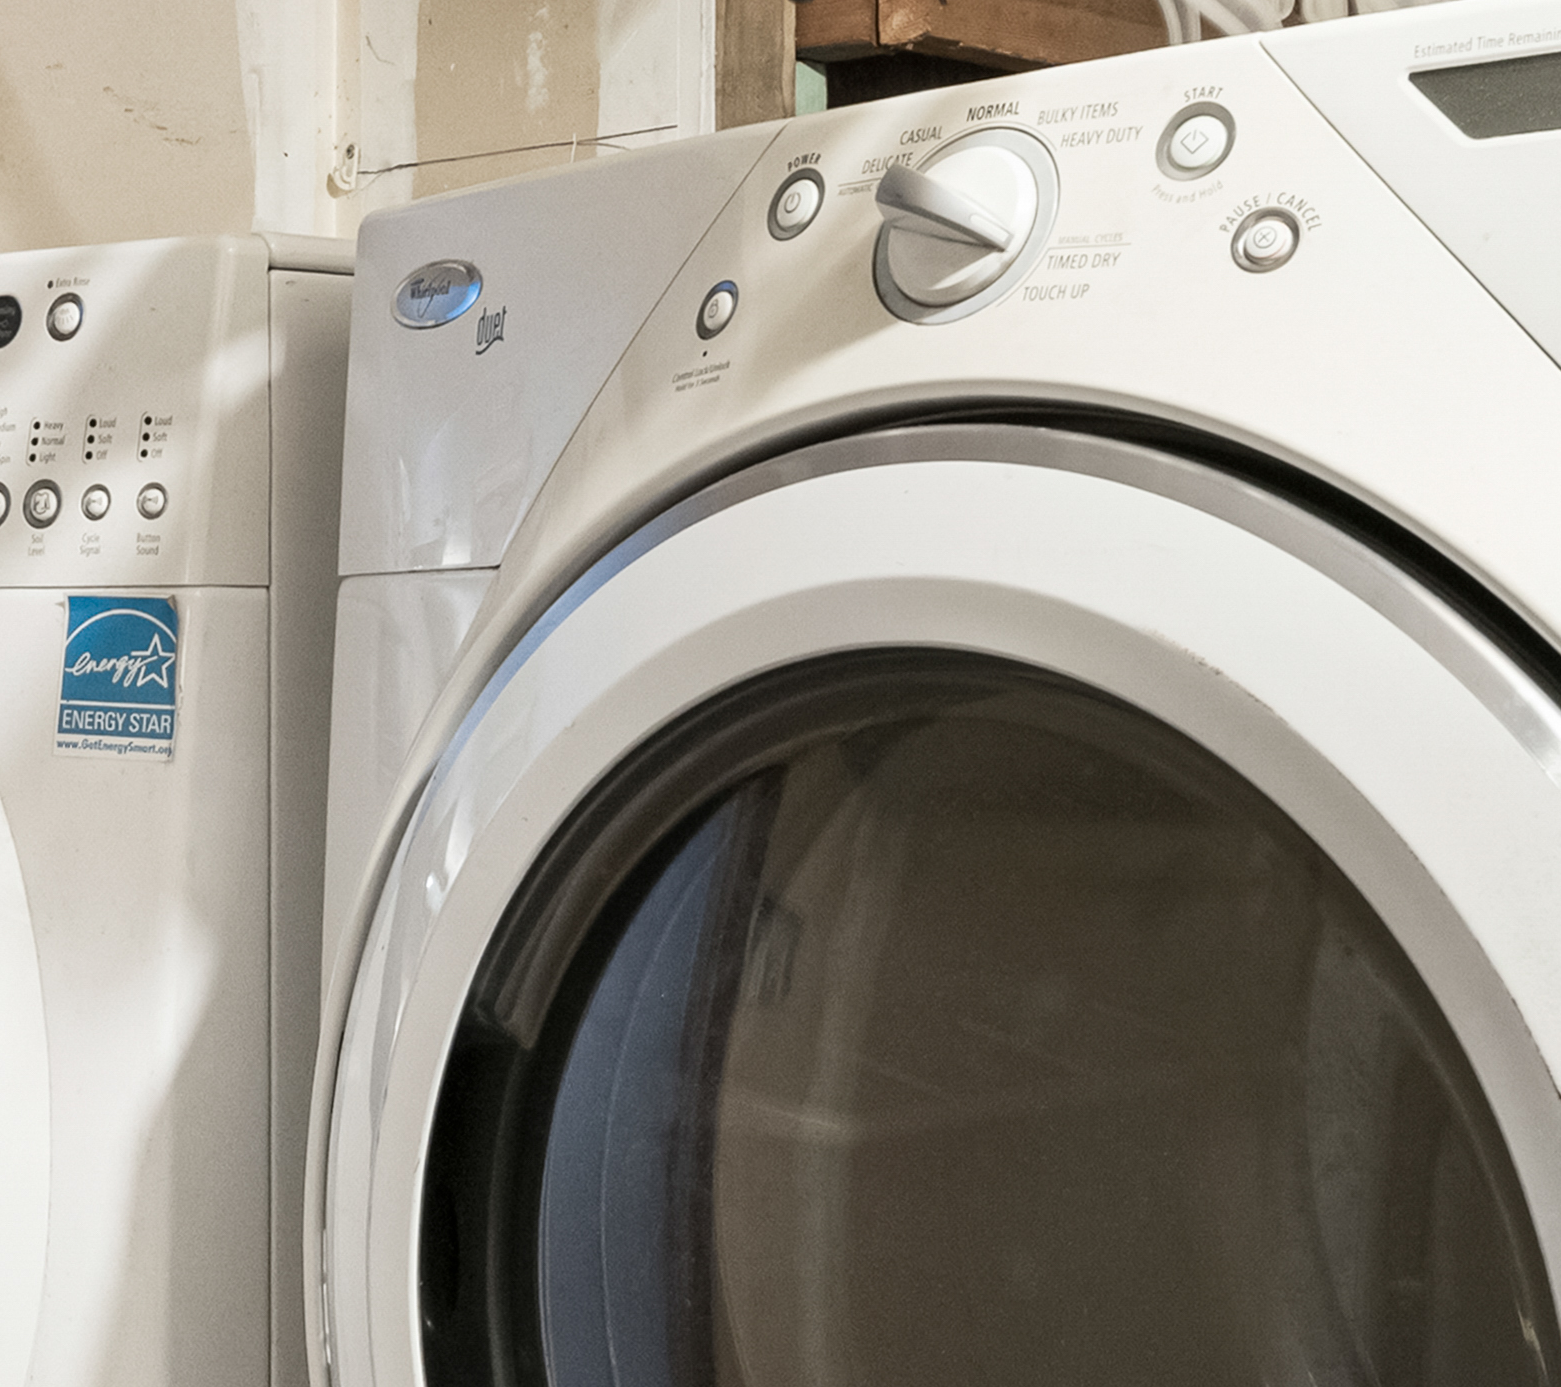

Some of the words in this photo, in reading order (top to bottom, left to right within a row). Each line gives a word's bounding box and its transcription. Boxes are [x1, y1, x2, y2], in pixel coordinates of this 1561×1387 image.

[1414, 37, 1473, 59] Estimated
[1476, 33, 1505, 51] Time
[1183, 86, 1224, 103] START
[965, 101, 1021, 123] NORMAL
[1036, 107, 1076, 126] BULKY
[1079, 102, 1119, 121] ITEMS
[899, 126, 943, 146] CASUAL
[1060, 129, 1104, 149] HEAVY
[1106, 125, 1144, 145] DUTY
[787, 152, 822, 172] POWER
[861, 152, 914, 175] DELICATE
[1198, 179, 1224, 199] Hold
[1218, 194, 1261, 233] PAUSE
[1276, 191, 1323, 232] CANCEL
[1058, 234, 1091, 245] MANUAL
[1093, 232, 1124, 243] CYCLES
[1046, 253, 1089, 270] TIMED
[1091, 251, 1122, 268] DRY
[55, 277, 72, 289] Extra
[73, 276, 91, 287] Rinse
[1022, 286, 1067, 303] TOUCH
[1070, 283, 1090, 299] UP
[476, 305, 507, 349] duet
[44, 421, 64, 432] Heavy
[99, 417, 117, 429] Loud
[154, 415, 173, 427] Loud
[41, 435, 65, 446] Normal
[97, 434, 113, 444] Soft
[152, 431, 168, 442] Soft
[39, 451, 56, 464] Light
[95, 449, 108, 460] Off
[150, 448, 164, 459] Off
[31, 533, 44, 545] Soil
[81, 533, 100, 545] Cycle
[136, 532, 161, 544] Button
[28, 546, 46, 557] Level
[79, 545, 102, 558] Signal
[136, 545, 160, 556] Sound
[65, 652, 144, 688] energy
[62, 708, 127, 732] ENERGY
[128, 712, 172, 734] STAR
